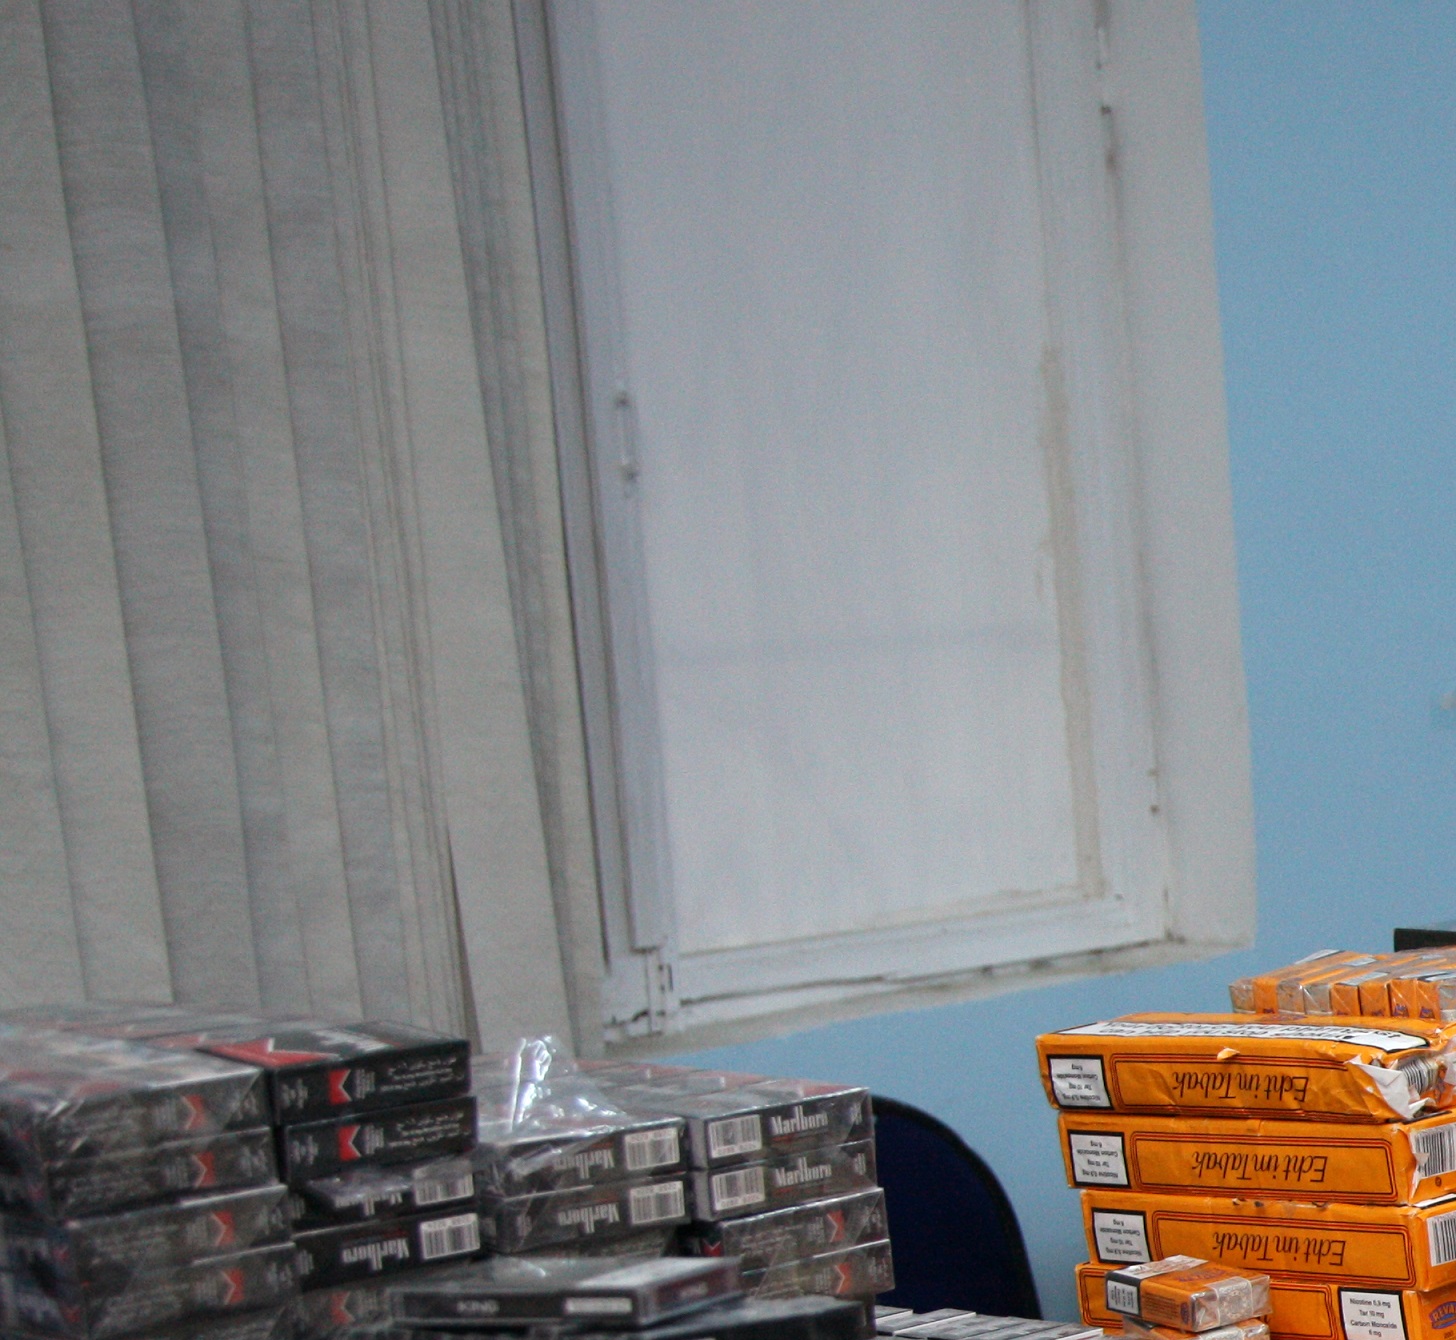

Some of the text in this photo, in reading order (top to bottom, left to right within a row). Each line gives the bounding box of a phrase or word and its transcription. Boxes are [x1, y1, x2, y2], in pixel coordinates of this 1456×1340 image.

[1172, 1072, 1232, 1099] Tabak
[1265, 1075, 1309, 1102] Echt
[1212, 1231, 1272, 1262] Tabak
[1304, 1236, 1346, 1266] Echt
